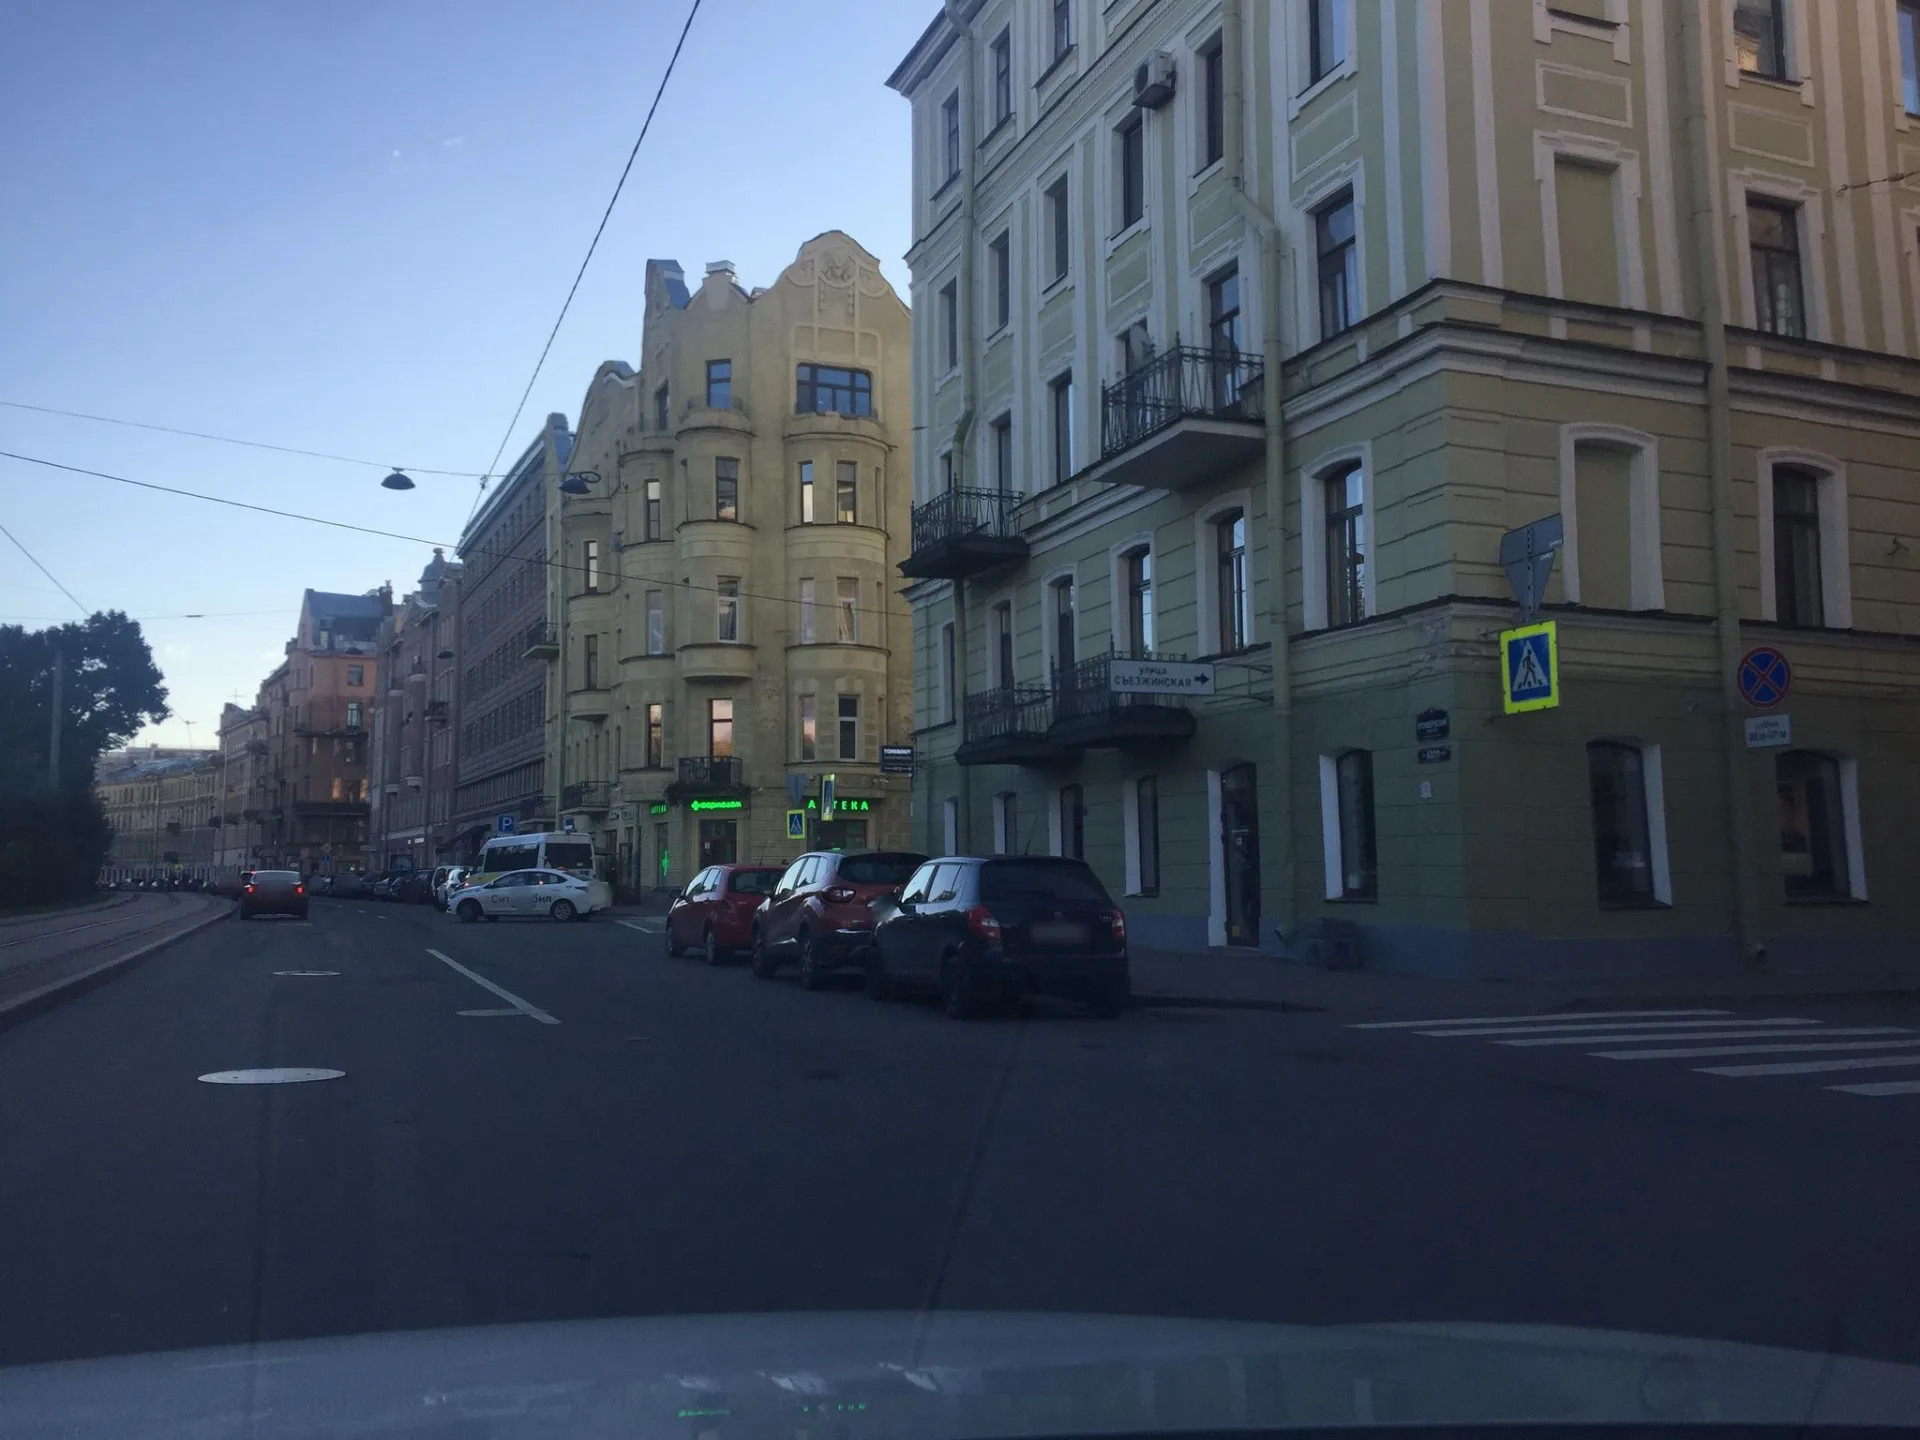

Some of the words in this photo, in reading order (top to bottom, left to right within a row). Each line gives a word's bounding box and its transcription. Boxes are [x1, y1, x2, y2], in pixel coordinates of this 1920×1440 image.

[1139, 667, 1168, 676] улица
[1114, 676, 1192, 688] СЪЕЗЖИНСКАЯ
[808, 799, 869, 811] АТЕКА
